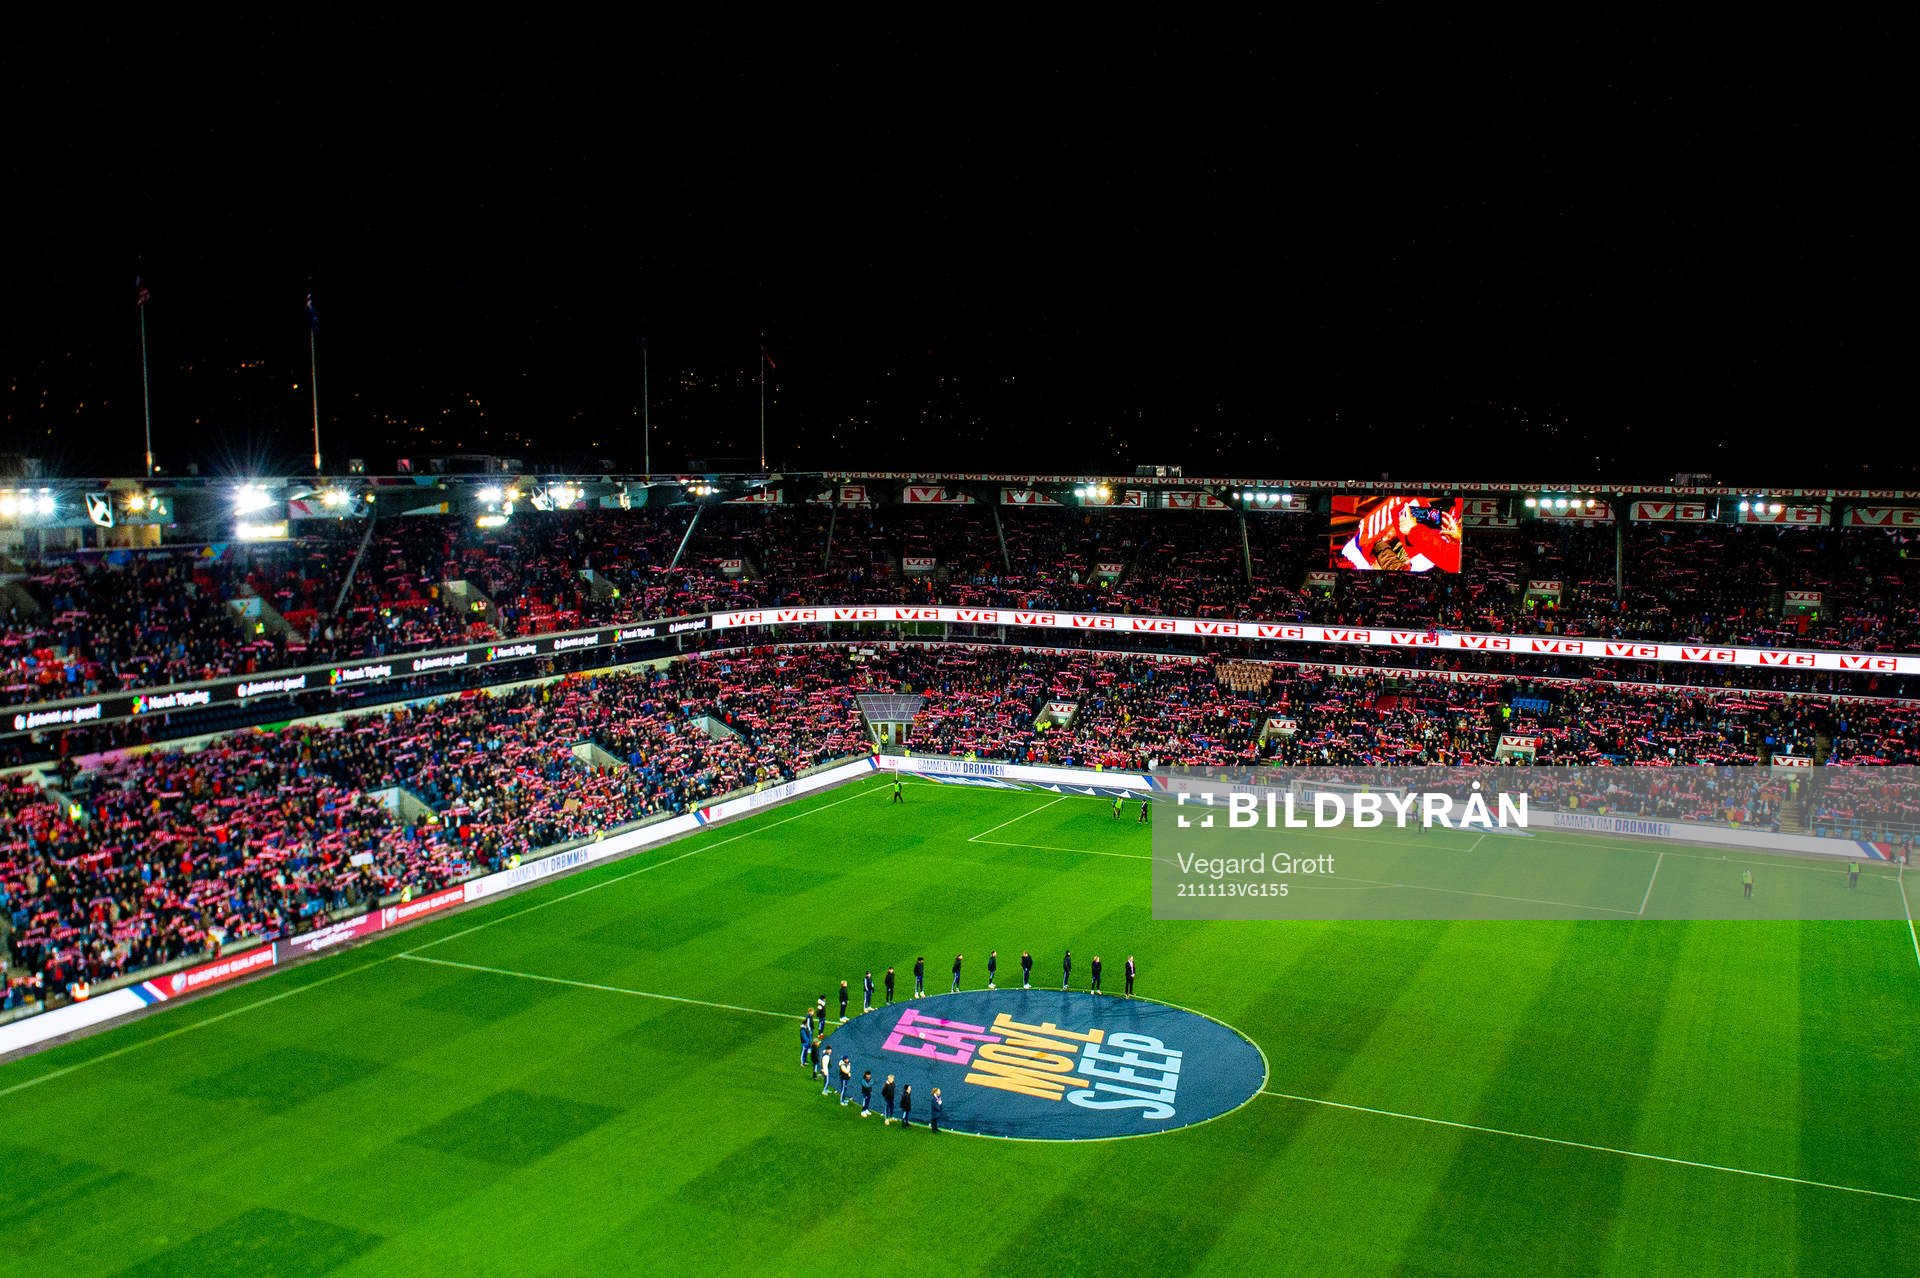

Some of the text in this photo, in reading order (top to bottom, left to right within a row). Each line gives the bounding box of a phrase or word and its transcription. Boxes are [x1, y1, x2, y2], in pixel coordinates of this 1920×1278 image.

[1640, 502, 1704, 520] VG
[730, 609, 1897, 670] VG VG VG VG VG VG VG VG VG VG VG VG VG VG VG VG VG VG
[1504, 737, 1534, 746] VG
[917, 759, 1005, 777] SAMMEN OM DRØMMEN
[1775, 757, 1810, 768] VG
[1554, 813, 1671, 837] SAMMEN OM DRØMMEN
[881, 1008, 1001, 1065] EAT
[964, 1012, 1104, 1101] MOVE
[1066, 1032, 1183, 1120] SLEEP
